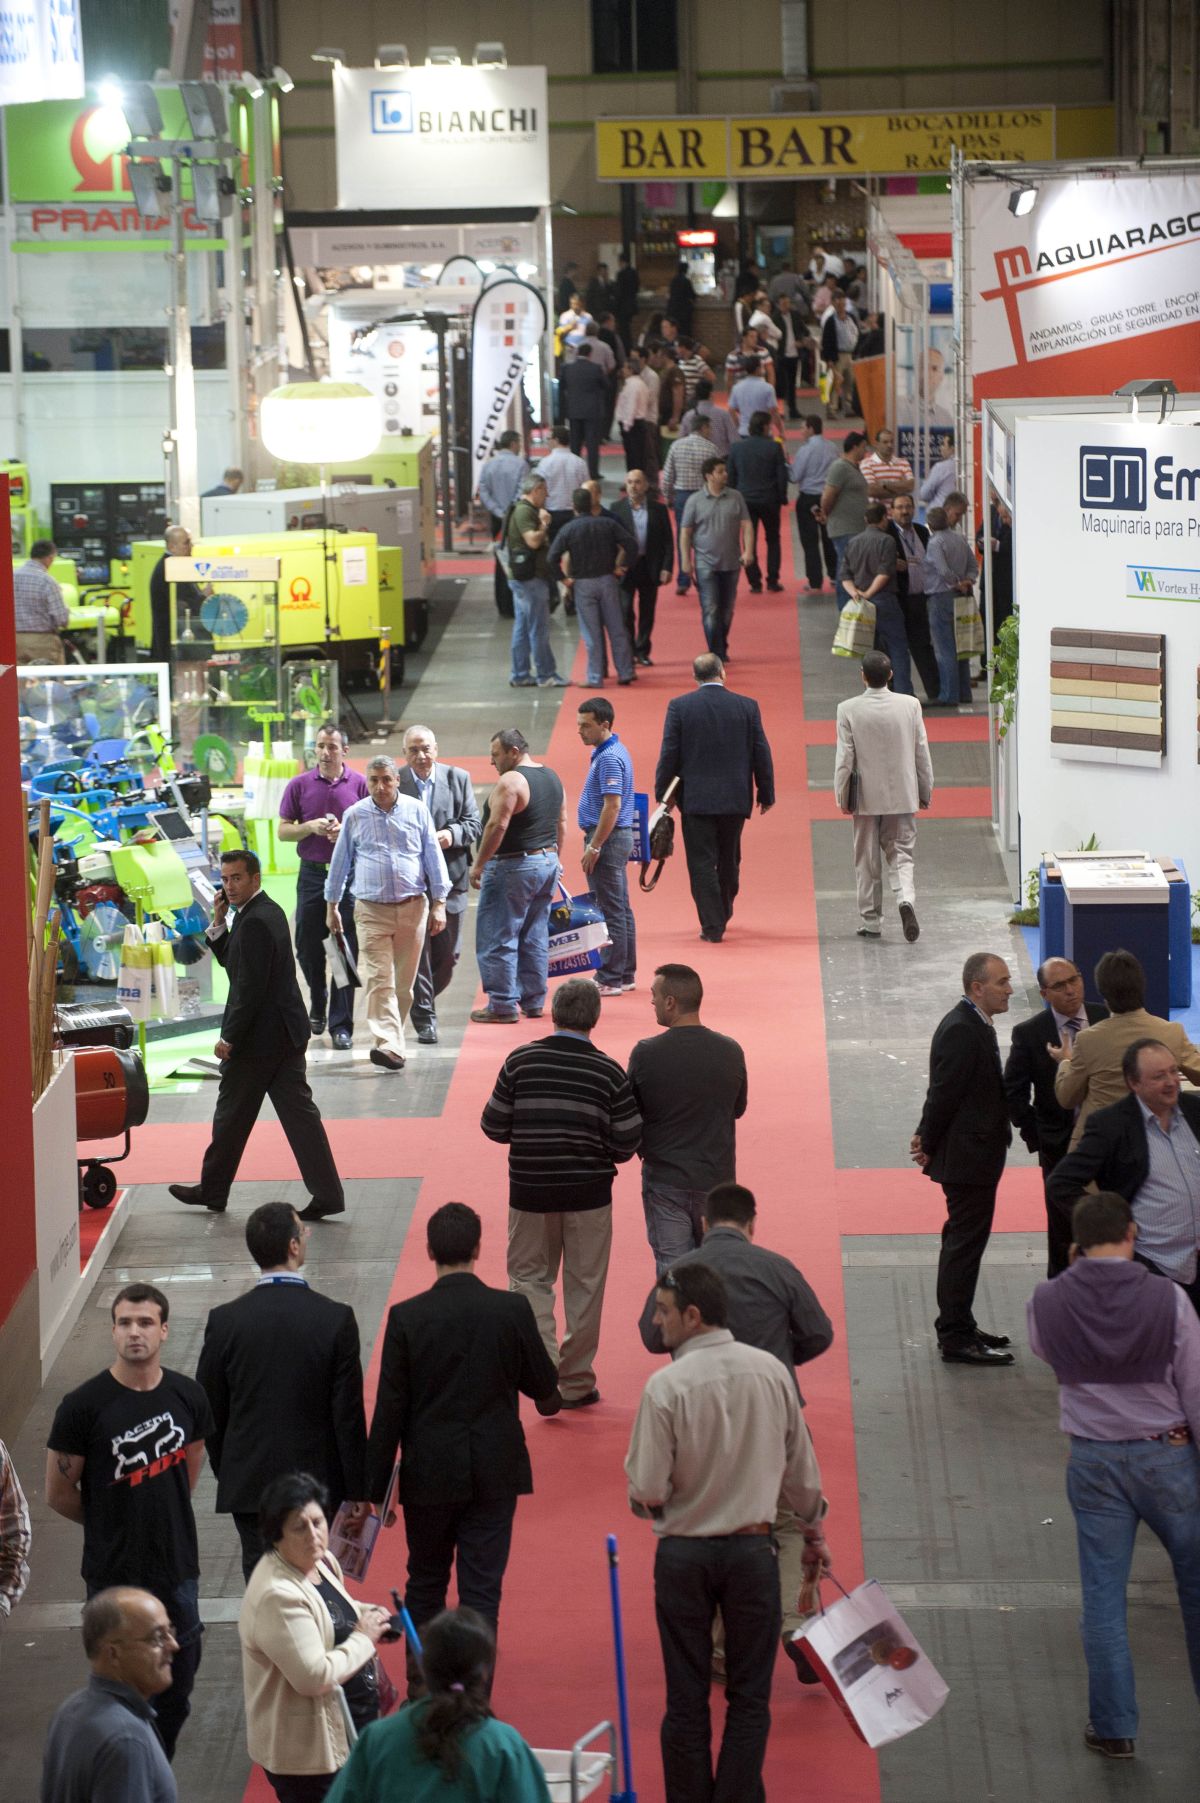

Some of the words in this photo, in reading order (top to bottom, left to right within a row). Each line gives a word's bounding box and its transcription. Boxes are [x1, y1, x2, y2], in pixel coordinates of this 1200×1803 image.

[419, 108, 537, 133] BIANCHI
[887, 112, 1042, 132] BOCADILLOS
[619, 128, 706, 169] BAR
[737, 125, 857, 168] BAR
[930, 133, 1000, 149] TAPAS
[1029, 320, 1083, 342] ANDAMIOS
[1090, 309, 1124, 327] GRUAS
[1126, 301, 1157, 318] TORRE
[1031, 327, 1107, 354] IMPLANTACIÓN
[1109, 322, 1123, 336] DE
[1125, 308, 1183, 332] SEGURIDAD
[1185, 304, 1200, 317] EN
[1082, 513, 1151, 538] Maquinaria
[1155, 519, 1184, 540] para
[1157, 580, 1187, 595] Vortex
